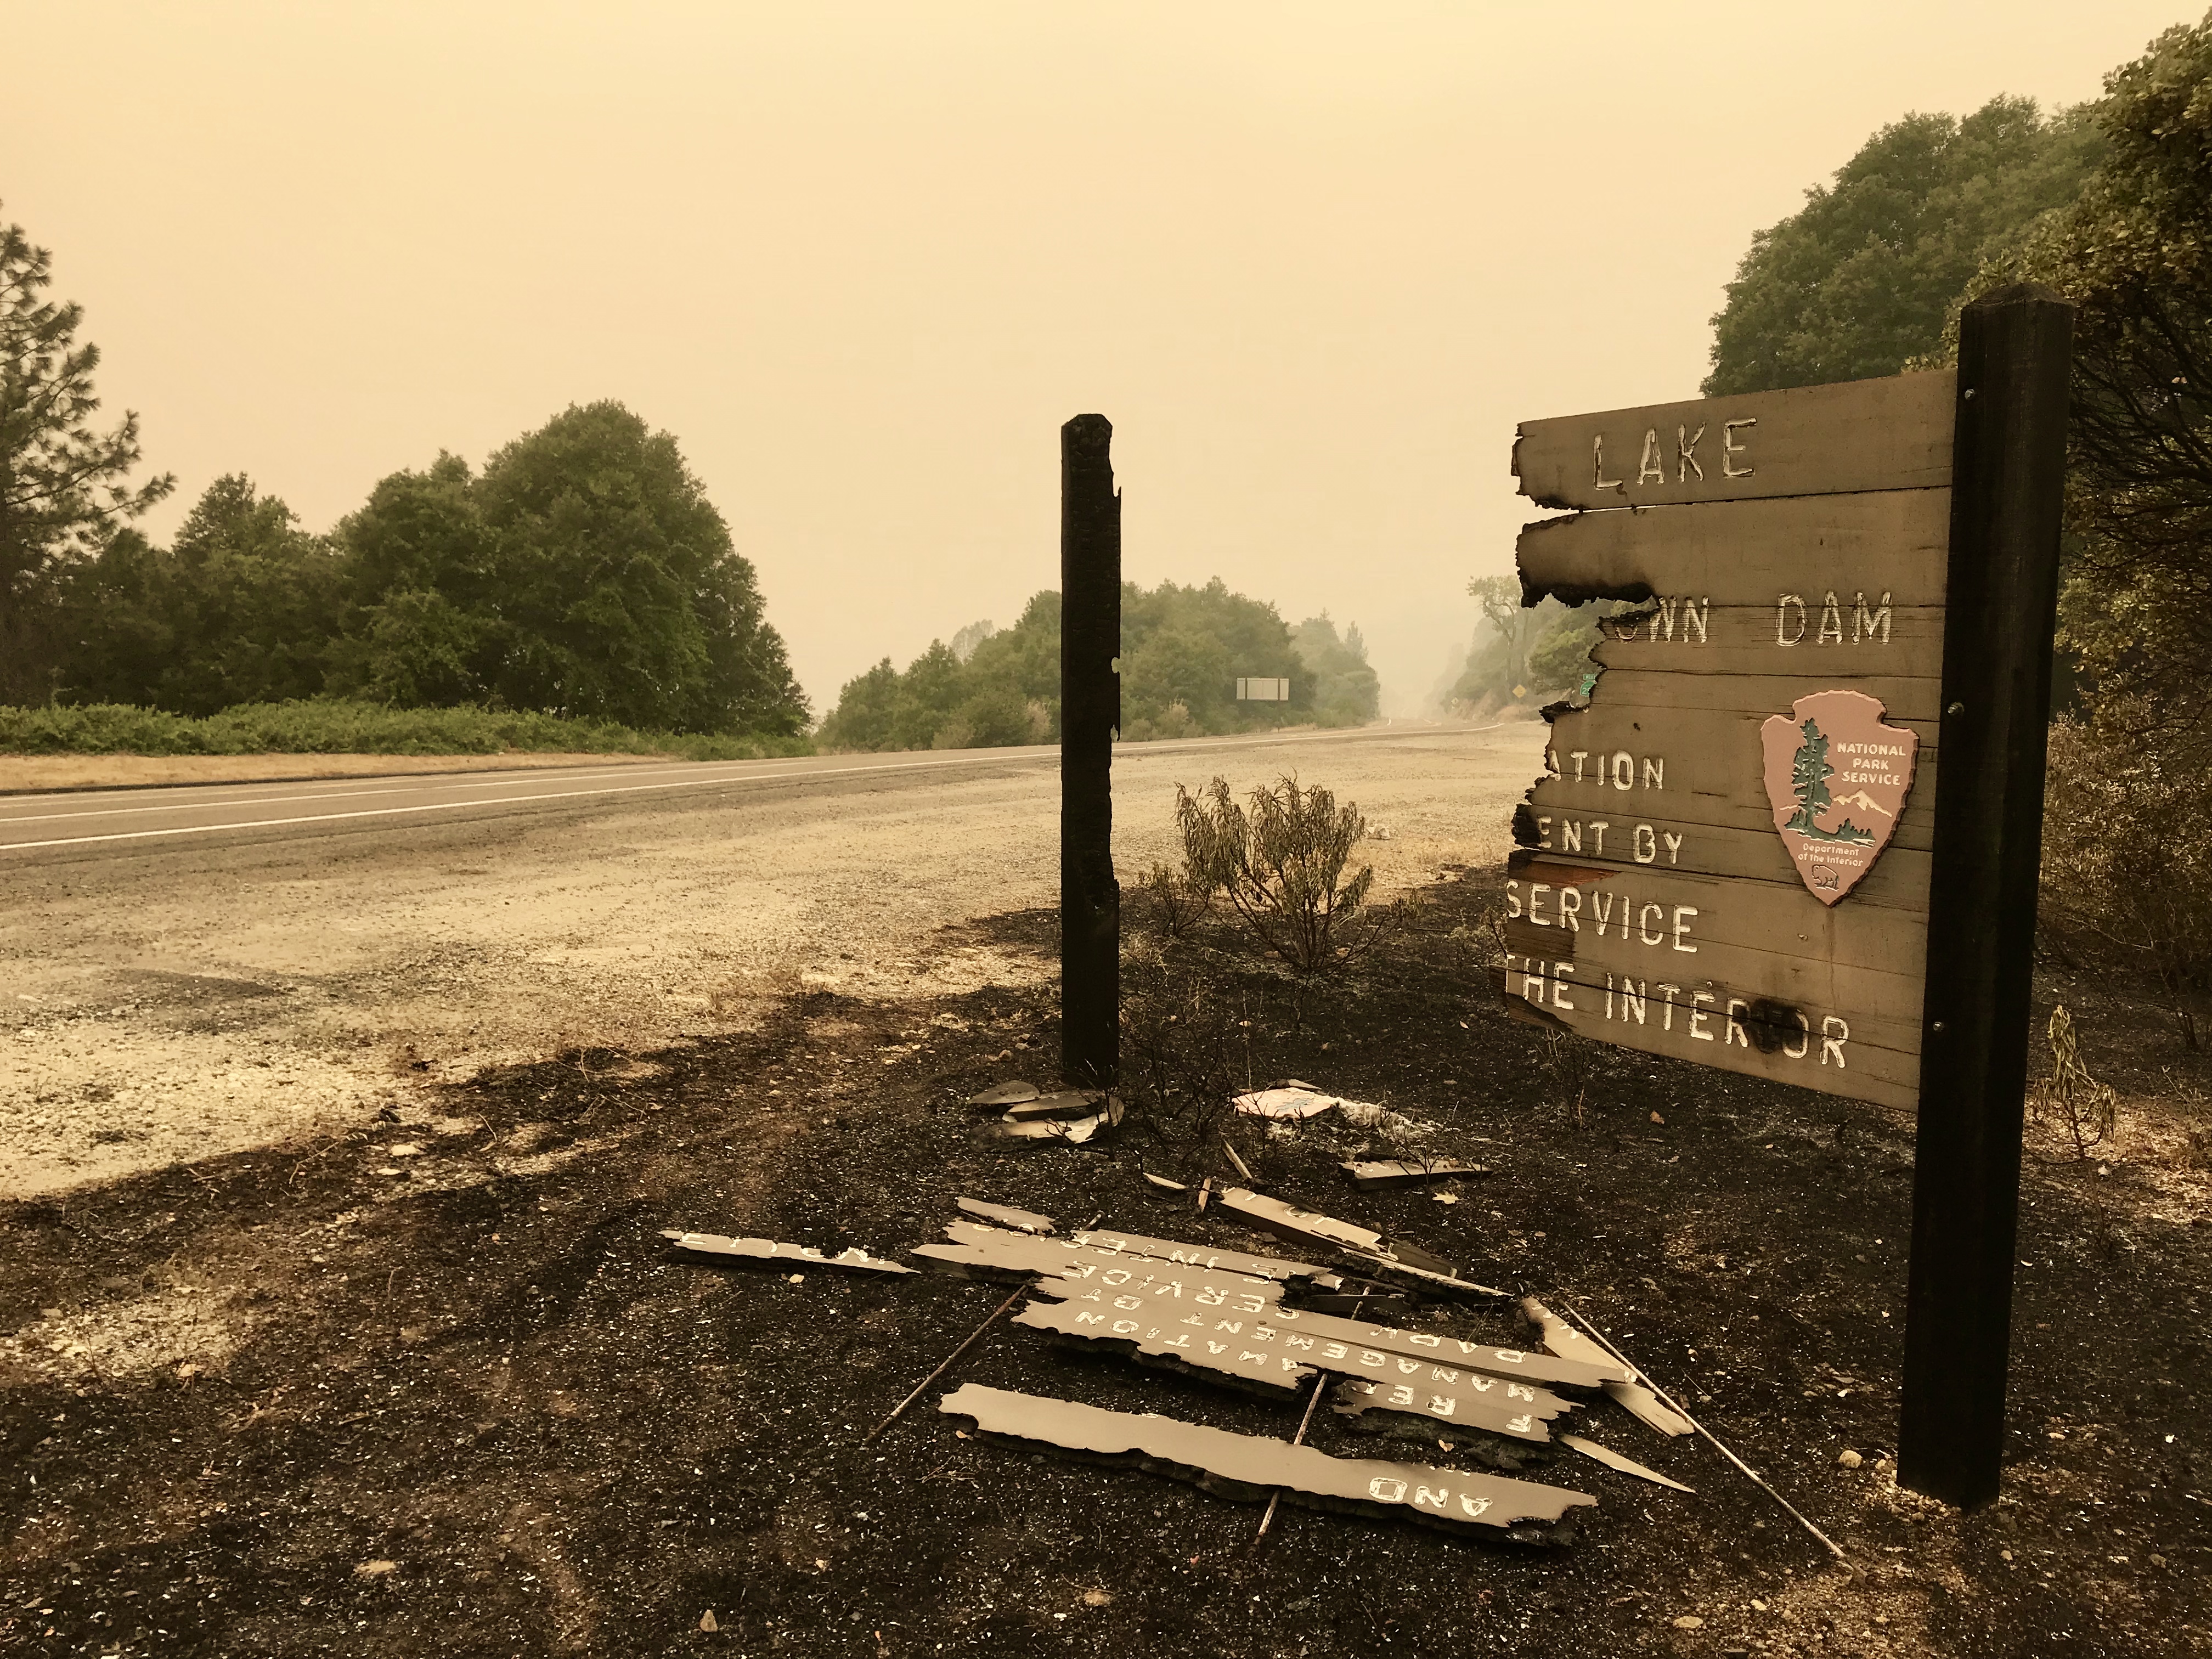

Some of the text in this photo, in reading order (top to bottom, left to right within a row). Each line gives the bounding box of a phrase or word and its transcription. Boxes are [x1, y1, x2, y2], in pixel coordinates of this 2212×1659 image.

[1593, 416, 1757, 490] LAKE
[1775, 589, 1893, 647] DAM
[1837, 742, 1906, 757] NATIONAL
[1853, 758, 1889, 770] PARK
[1841, 771, 1901, 786] SERVICE
[1633, 823, 1683, 864] BY
[1798, 853, 1808, 861] of
[1827, 855, 1864, 867] Interior
[1803, 843, 1860, 856] Department
[1506, 880, 1699, 953] SERVICE
[1605, 971, 1849, 1069] INTEROR
[1080, 1289, 1144, 1311] BY
[1180, 1312, 1536, 1403] MANAGEMENT
[1368, 1476, 1494, 1517] AND
